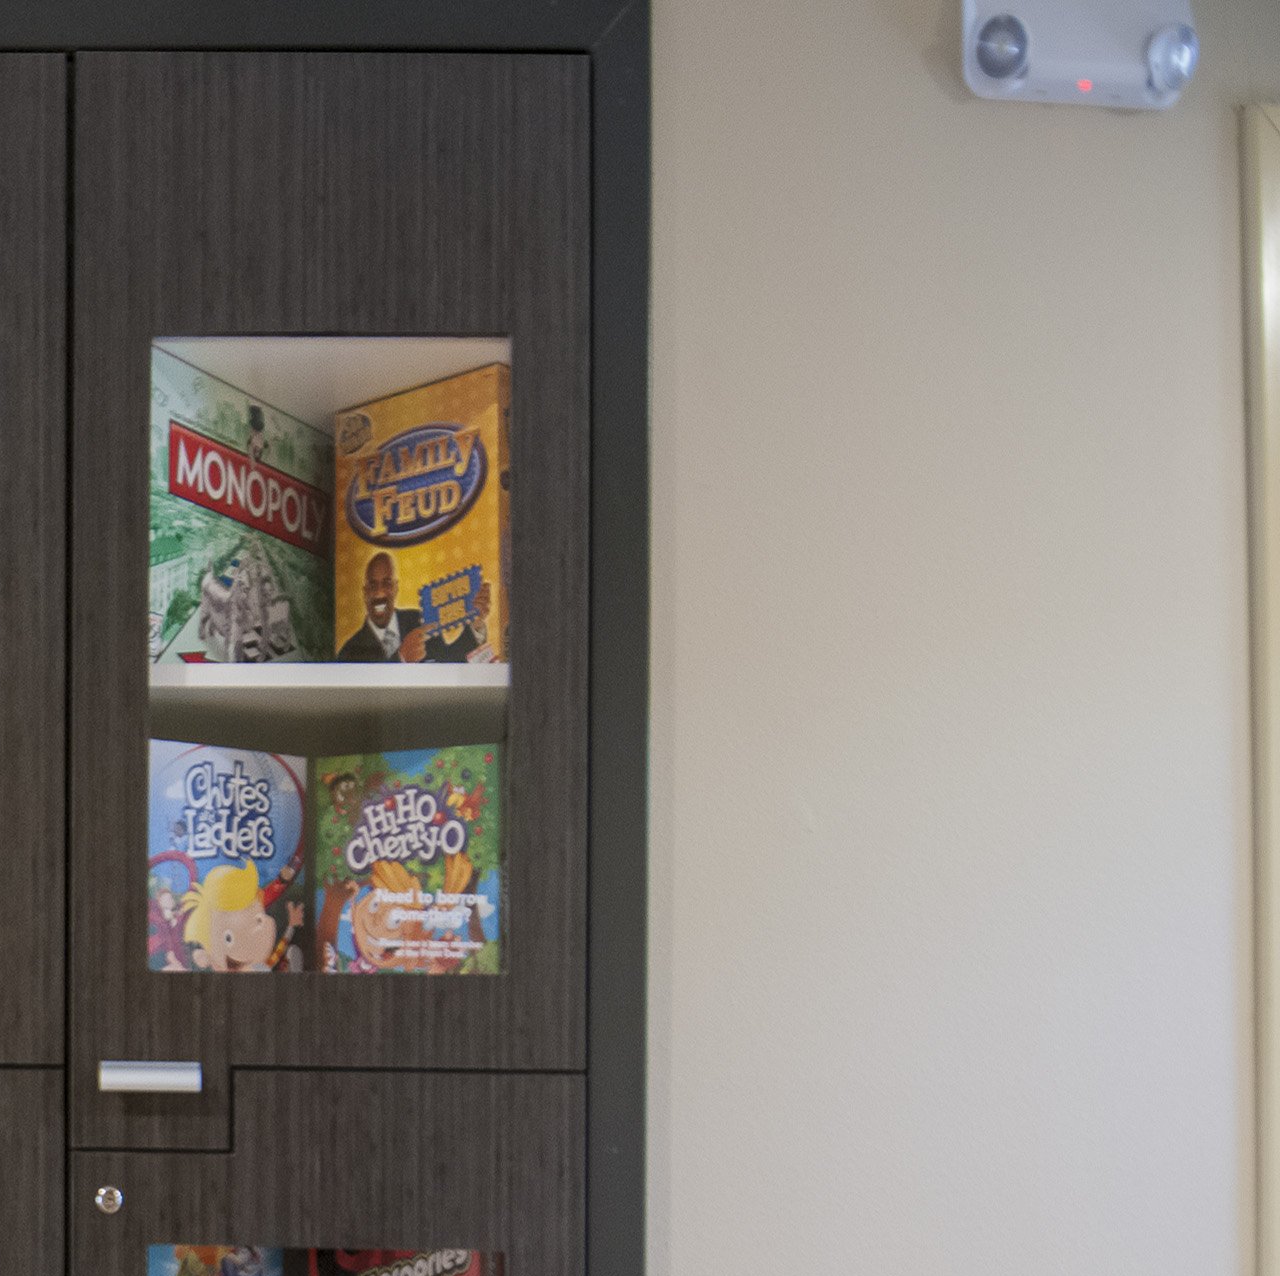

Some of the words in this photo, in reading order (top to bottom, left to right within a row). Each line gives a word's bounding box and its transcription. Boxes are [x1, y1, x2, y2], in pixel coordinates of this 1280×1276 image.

[176, 439, 327, 541] MONOPOLY
[355, 428, 480, 498] FAMILY
[371, 479, 462, 536] FEUD
[186, 761, 270, 817] Chutes
[184, 808, 274, 858] Ladders
[376, 888, 415, 904] Need
[417, 889, 434, 905] to
